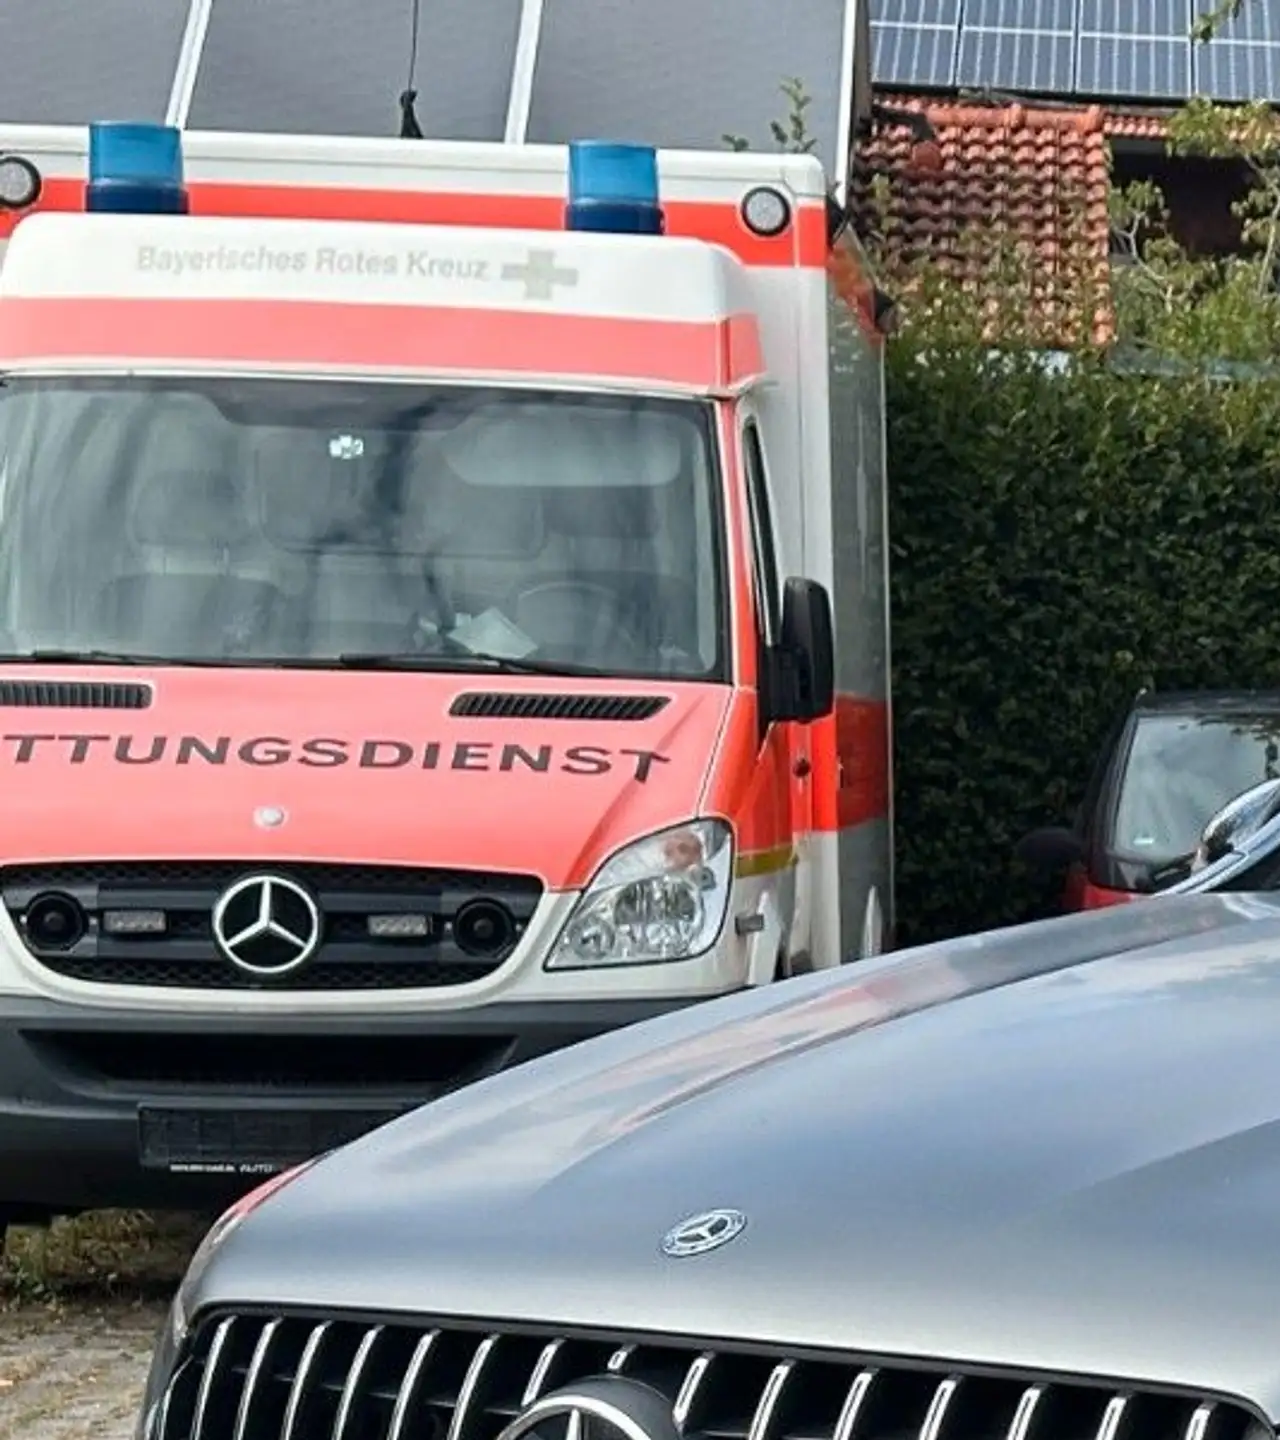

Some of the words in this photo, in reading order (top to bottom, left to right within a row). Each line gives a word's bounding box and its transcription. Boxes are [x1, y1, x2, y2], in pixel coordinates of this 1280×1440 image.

[136, 244, 306, 274] Bayerisches
[314, 248, 398, 276] Rotes
[406, 251, 491, 281] Kreuz
